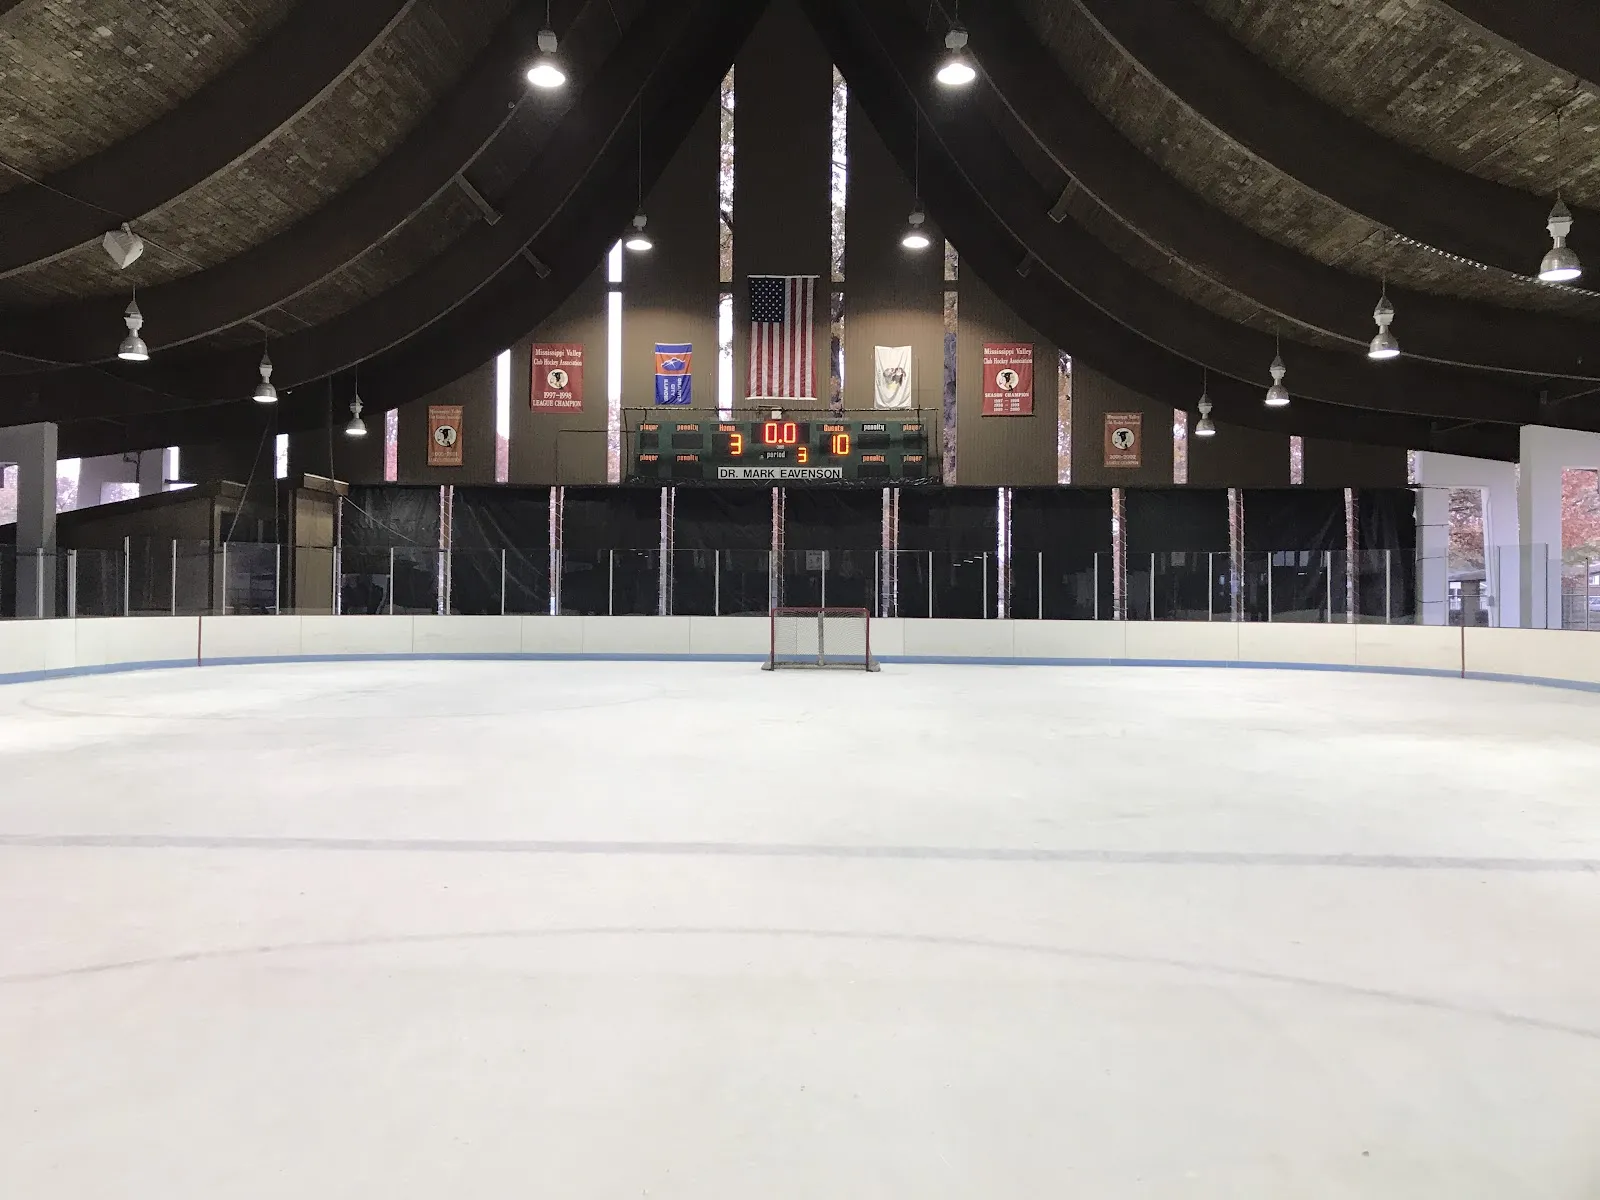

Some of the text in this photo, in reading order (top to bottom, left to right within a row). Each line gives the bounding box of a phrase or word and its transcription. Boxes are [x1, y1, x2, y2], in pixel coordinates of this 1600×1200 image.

[535, 349, 582, 357] Mississippi Valley
[543, 359, 558, 367] Hockey
[532, 399, 553, 407] LEAGUE
[639, 423, 659, 431] player
[676, 423, 699, 431] penalty
[719, 424, 736, 432] Home
[823, 424, 844, 432] Guests
[863, 423, 885, 432] penalty
[902, 423, 922, 431] player
[765, 422, 796, 444] 0.0
[730, 433, 742, 455] 3
[832, 433, 850, 455] 10
[639, 454, 659, 462] player
[676, 454, 699, 462] penalty
[766, 451, 786, 459] period
[797, 446, 807, 463] 3
[862, 455, 885, 463] penalty
[903, 455, 923, 463] player
[720, 469, 841, 478] DR. MARK EAVENSON
